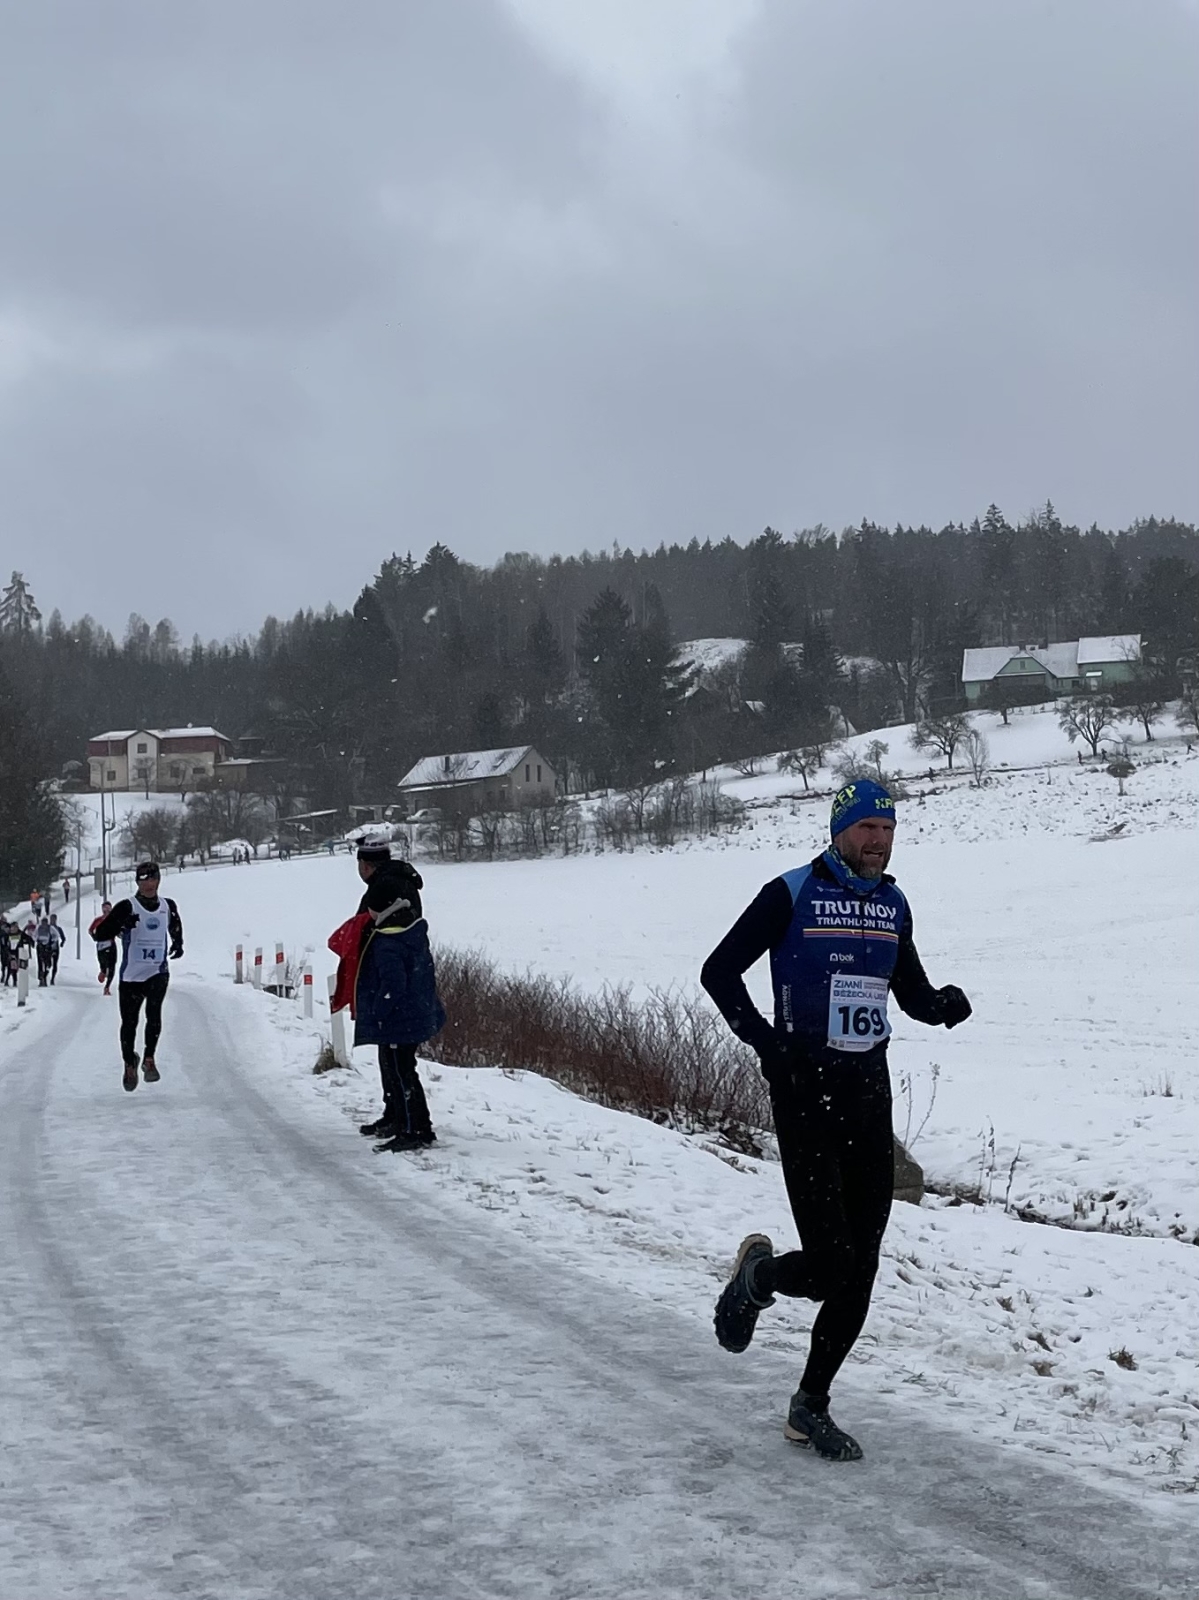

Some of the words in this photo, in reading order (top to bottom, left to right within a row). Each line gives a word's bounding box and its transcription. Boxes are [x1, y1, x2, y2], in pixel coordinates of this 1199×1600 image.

[811, 900, 897, 920] TRUTNOV
[816, 917, 875, 928] TRIATHLON
[877, 920, 896, 931] TEAM
[142, 948, 156, 960] 14
[838, 1006, 885, 1036] 169
